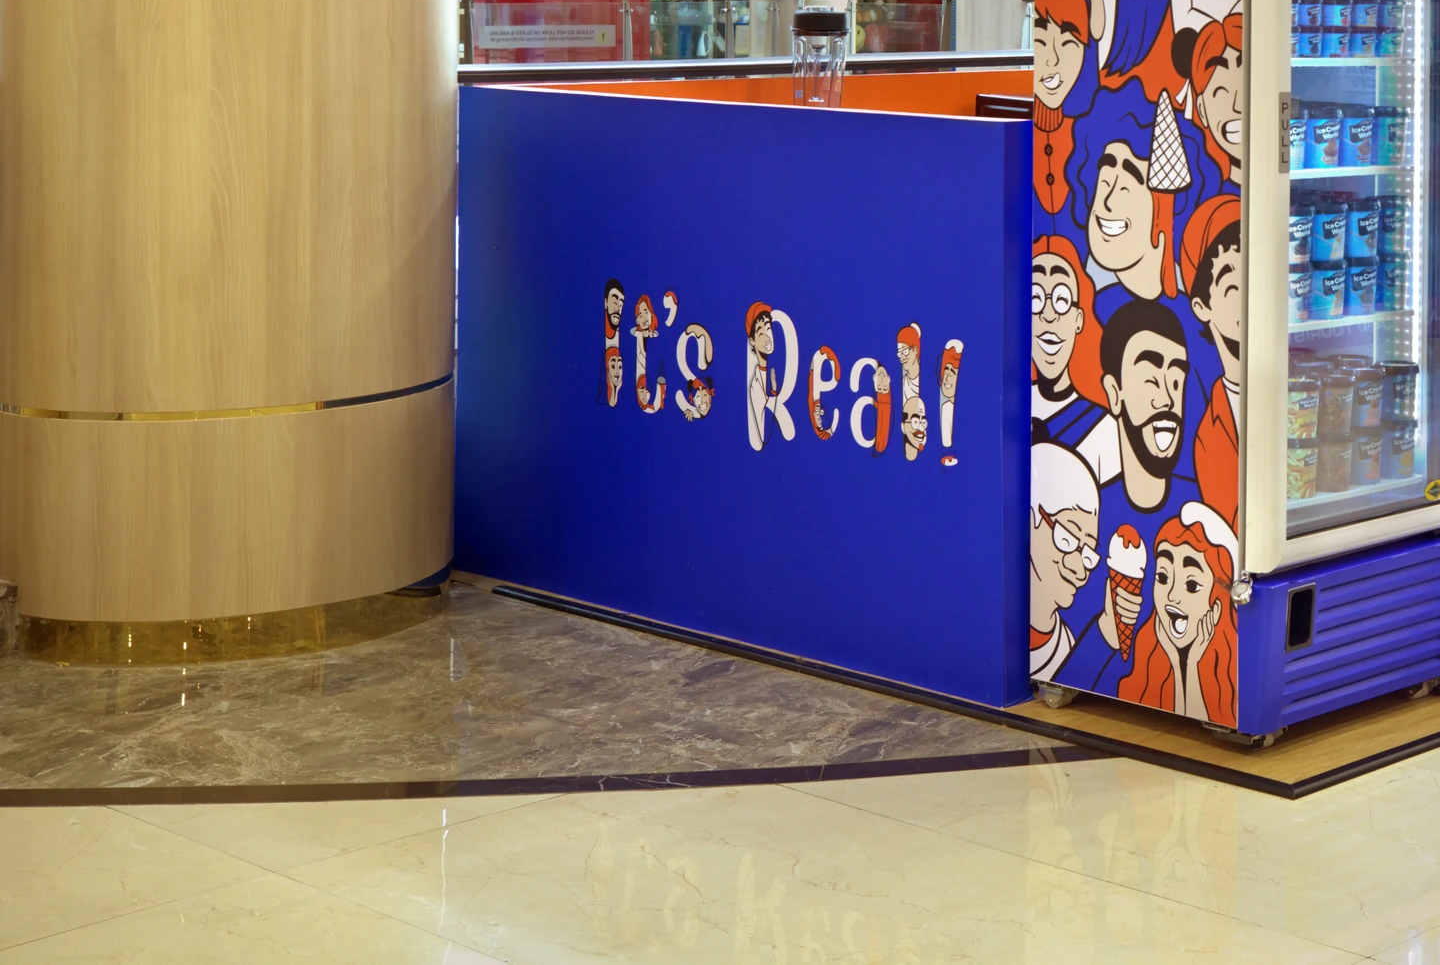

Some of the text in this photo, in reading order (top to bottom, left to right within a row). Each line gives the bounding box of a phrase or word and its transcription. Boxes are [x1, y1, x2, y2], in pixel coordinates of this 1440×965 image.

[1281, 102, 1289, 164] PULL
[603, 278, 965, 468] It's Real!
